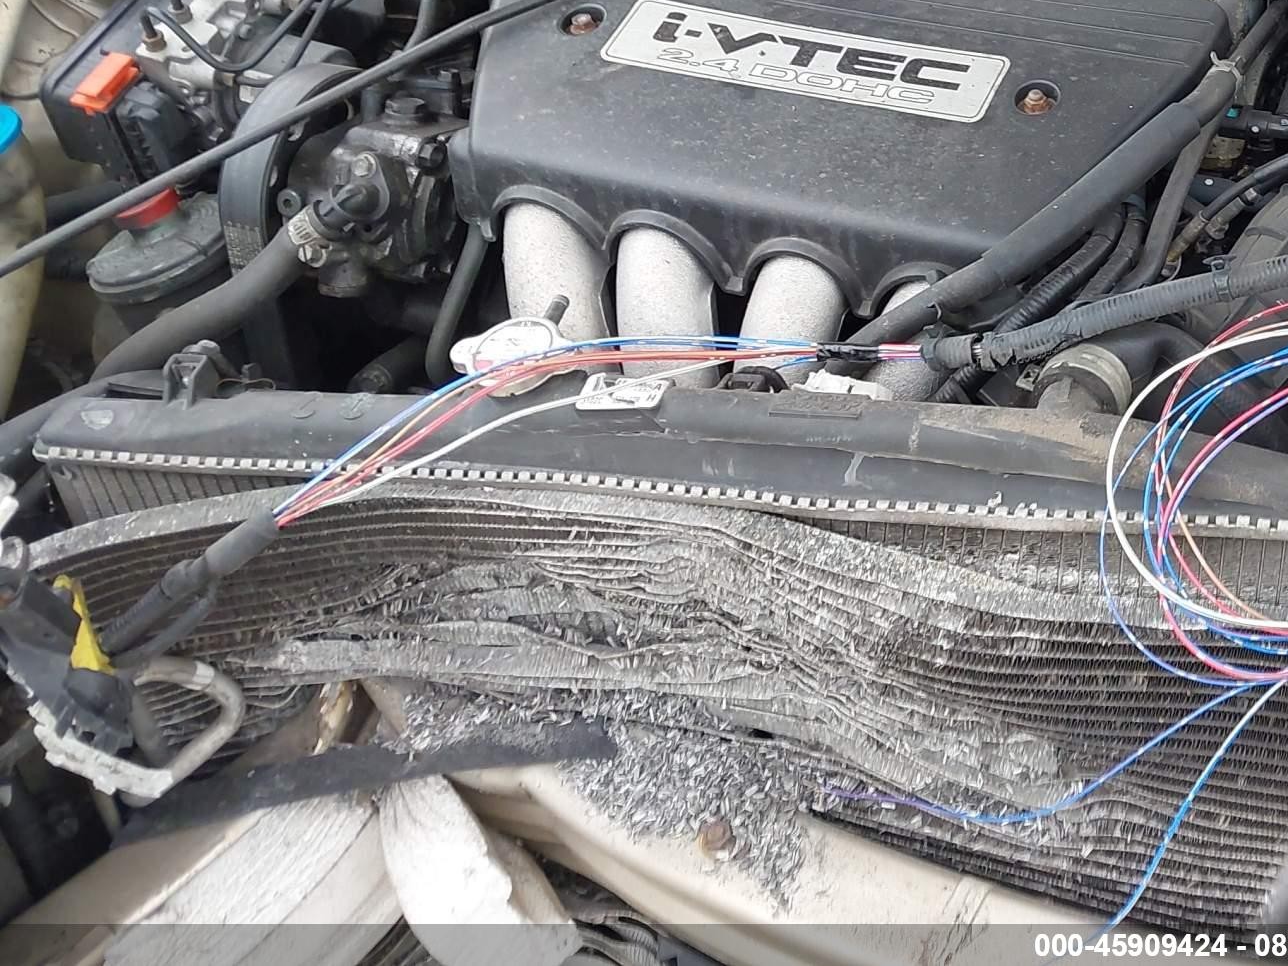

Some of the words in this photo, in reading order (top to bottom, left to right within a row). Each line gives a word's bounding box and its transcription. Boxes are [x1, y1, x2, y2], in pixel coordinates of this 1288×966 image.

[653, 11, 970, 90] i-VTEC
[657, 47, 740, 73] 2.4
[748, 62, 936, 105] DOHC
